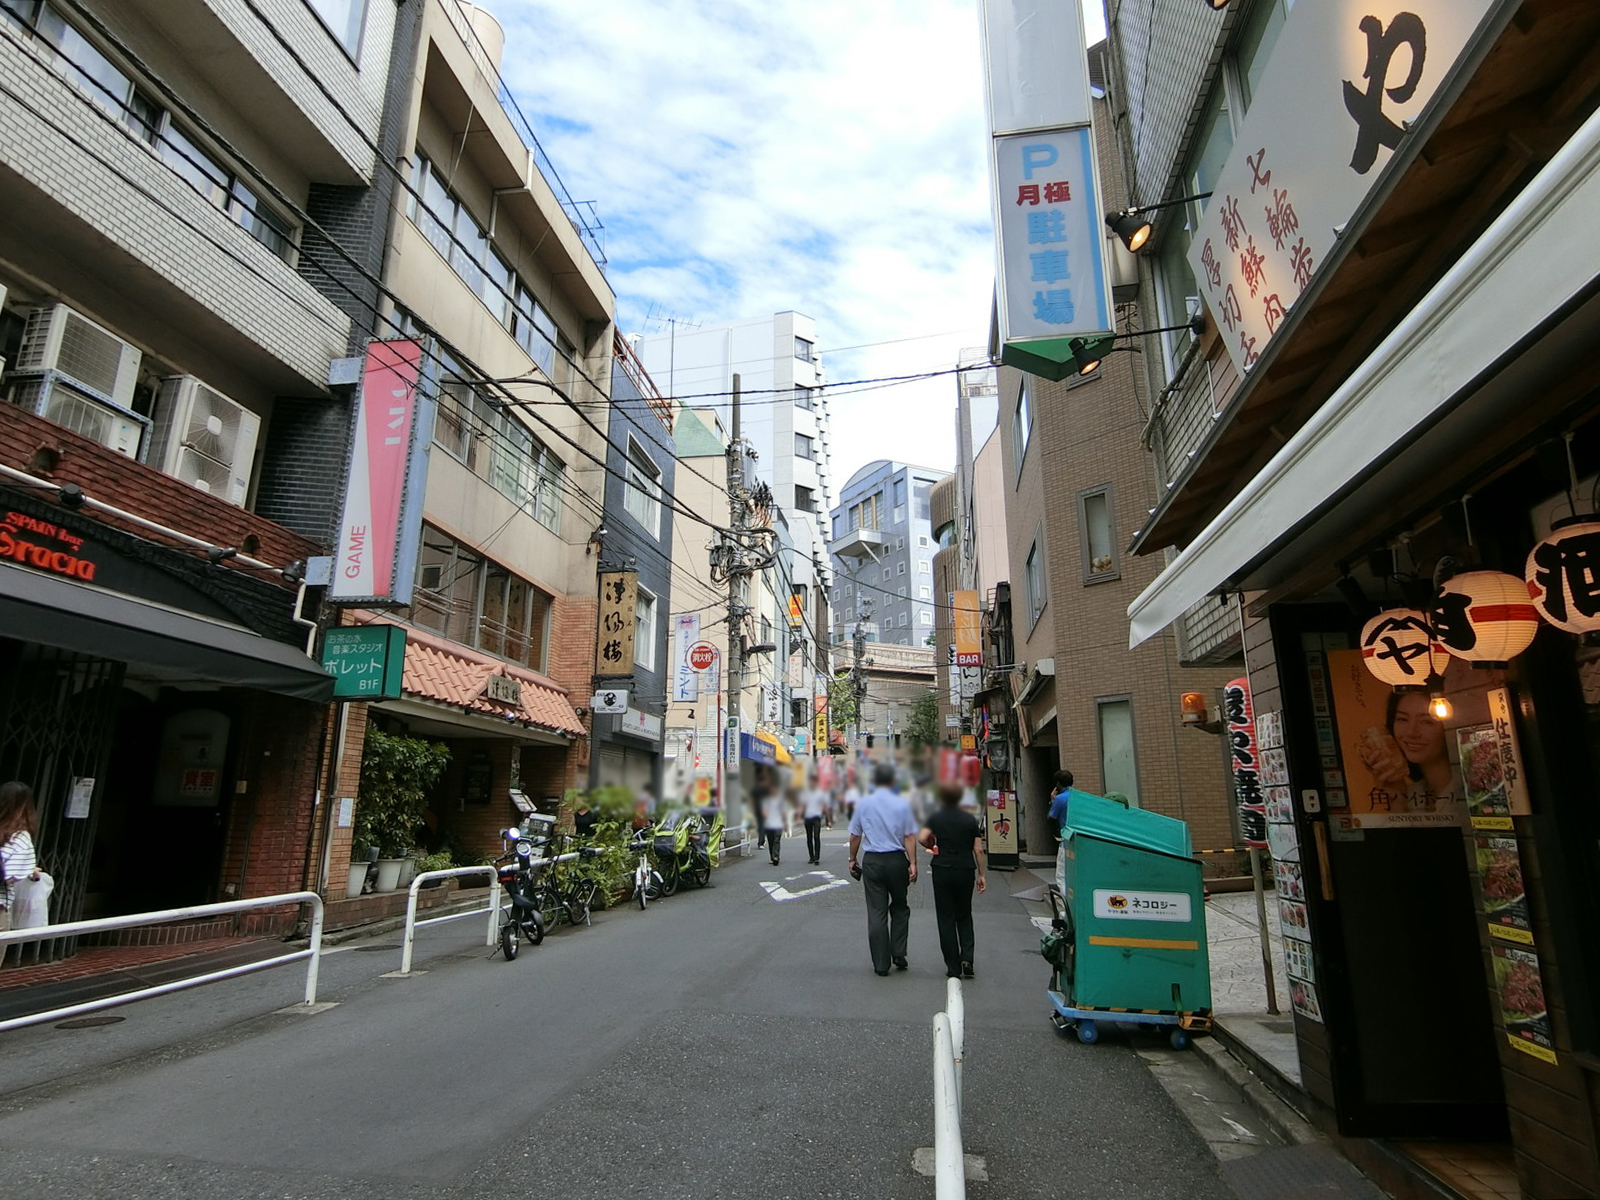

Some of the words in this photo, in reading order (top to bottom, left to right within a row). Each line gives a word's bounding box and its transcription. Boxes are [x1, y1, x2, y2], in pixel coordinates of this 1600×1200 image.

[1341, 11, 1427, 175] や
[1021, 143, 1059, 180] P
[1016, 180, 1071, 206] 月極
[1027, 210, 1074, 325] 駐車場
[5, 511, 58, 537] SPAIN
[57, 528, 84, 545] bar
[345, 525, 366, 579] GAME
[326, 633, 362, 645] お茶の水
[332, 643, 383, 655] 音楽スタジオ
[692, 653, 713, 662] 消火栓
[959, 654, 979, 664] BAR
[359, 679, 379, 691] B1F
[1388, 815, 1423, 823] SUNTORY
[1132, 897, 1178, 909] ネコロジー
